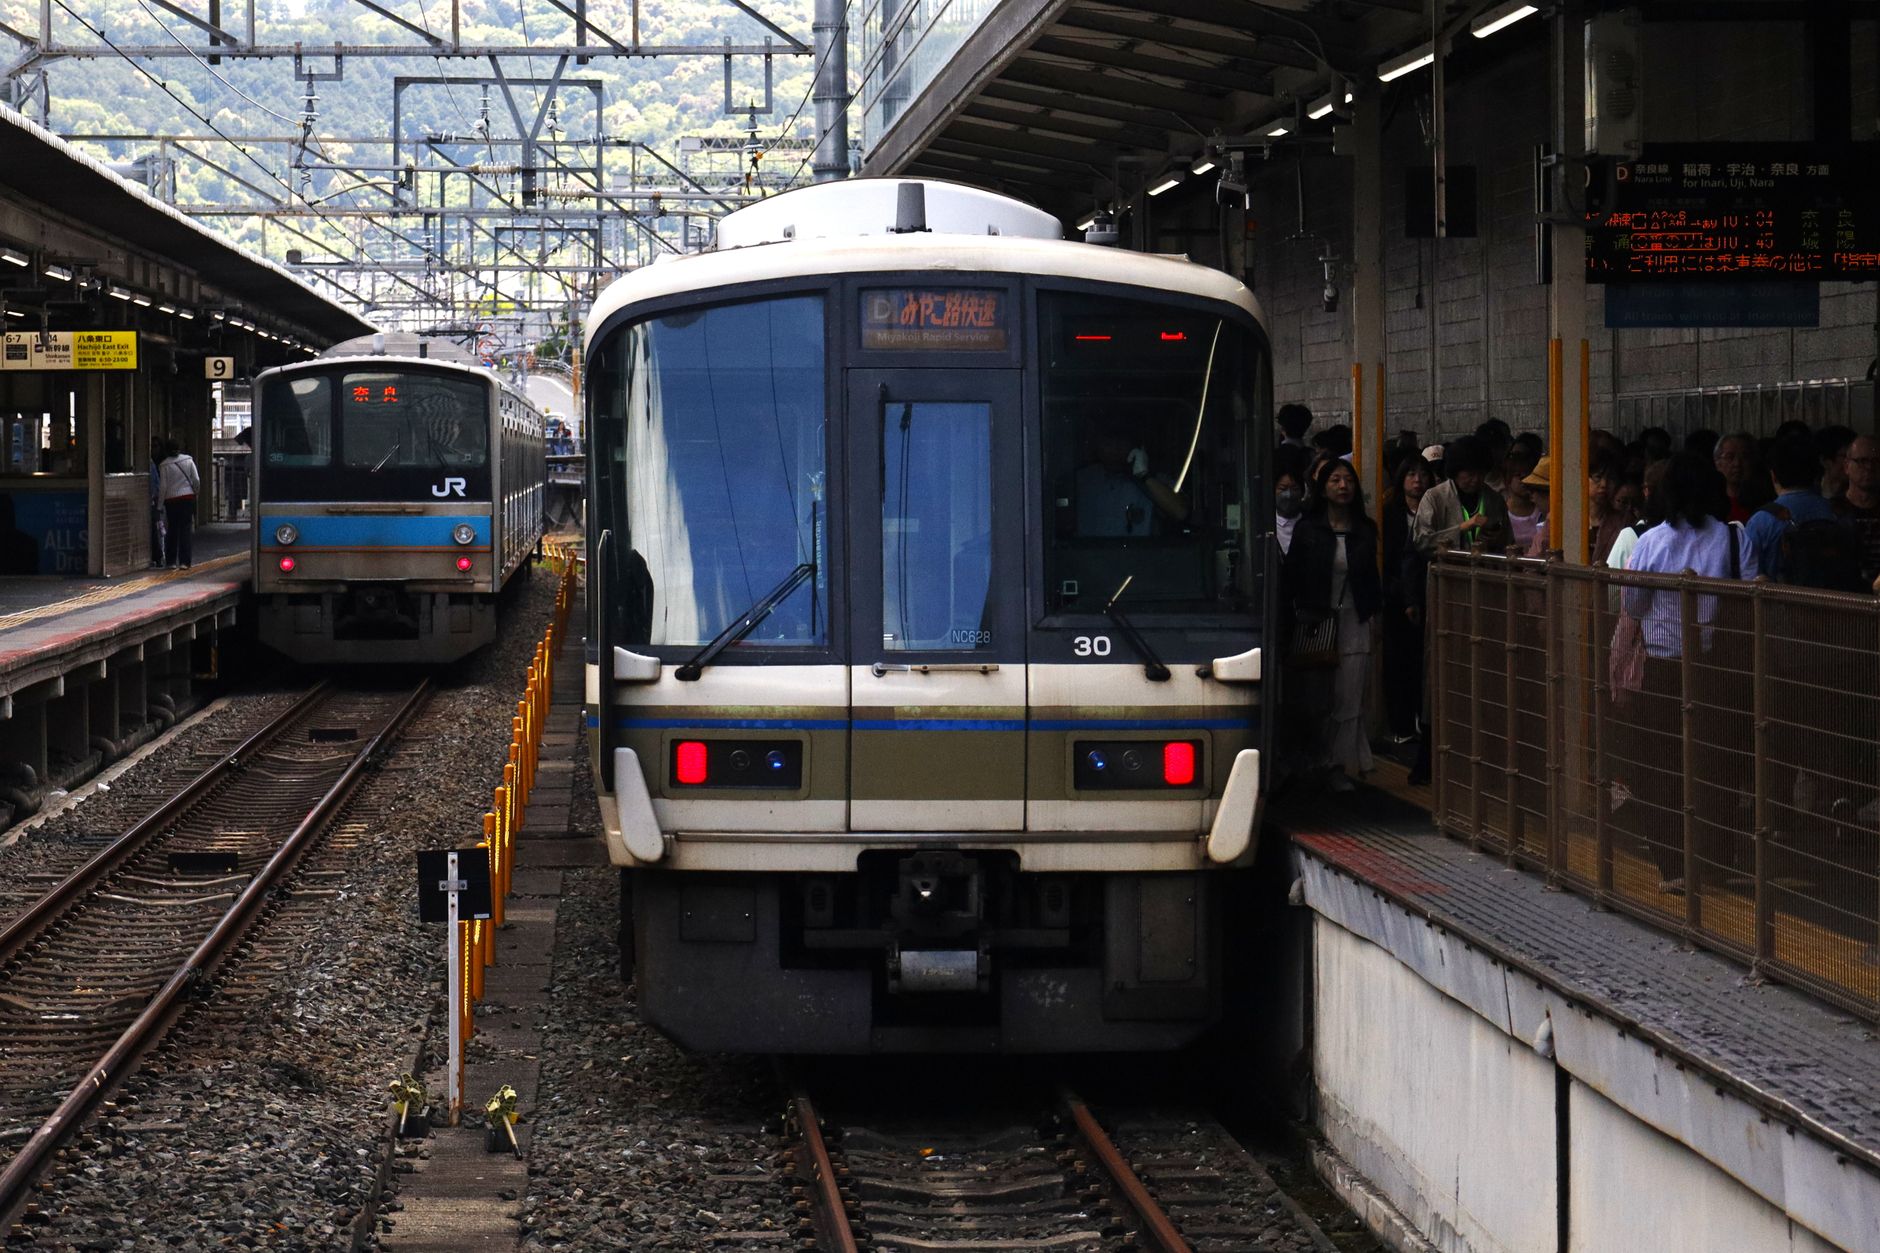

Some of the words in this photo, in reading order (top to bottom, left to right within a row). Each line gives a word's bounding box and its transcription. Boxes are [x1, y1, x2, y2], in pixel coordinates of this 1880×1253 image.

[1617, 167, 1629, 180] D
[1635, 164, 1669, 174] 奈良線
[1806, 164, 1830, 176] 方面
[1635, 176, 1654, 184] Nara
[1656, 175, 1672, 183] Line
[1683, 178, 1699, 188] for
[1701, 178, 1728, 190] Inari,
[1750, 178, 1775, 188] Nara
[873, 299, 890, 320] D
[900, 291, 997, 328] みやこ路快速
[78, 335, 112, 343] 八条東口
[878, 332, 921, 344] Miyakoji
[922, 332, 952, 344] Rapid
[955, 332, 990, 342] Service
[213, 359, 226, 377] 9
[432, 477, 467, 497] JR
[44, 529, 75, 551] ALL
[952, 630, 991, 644] NC628
[1073, 635, 1112, 657] 30
